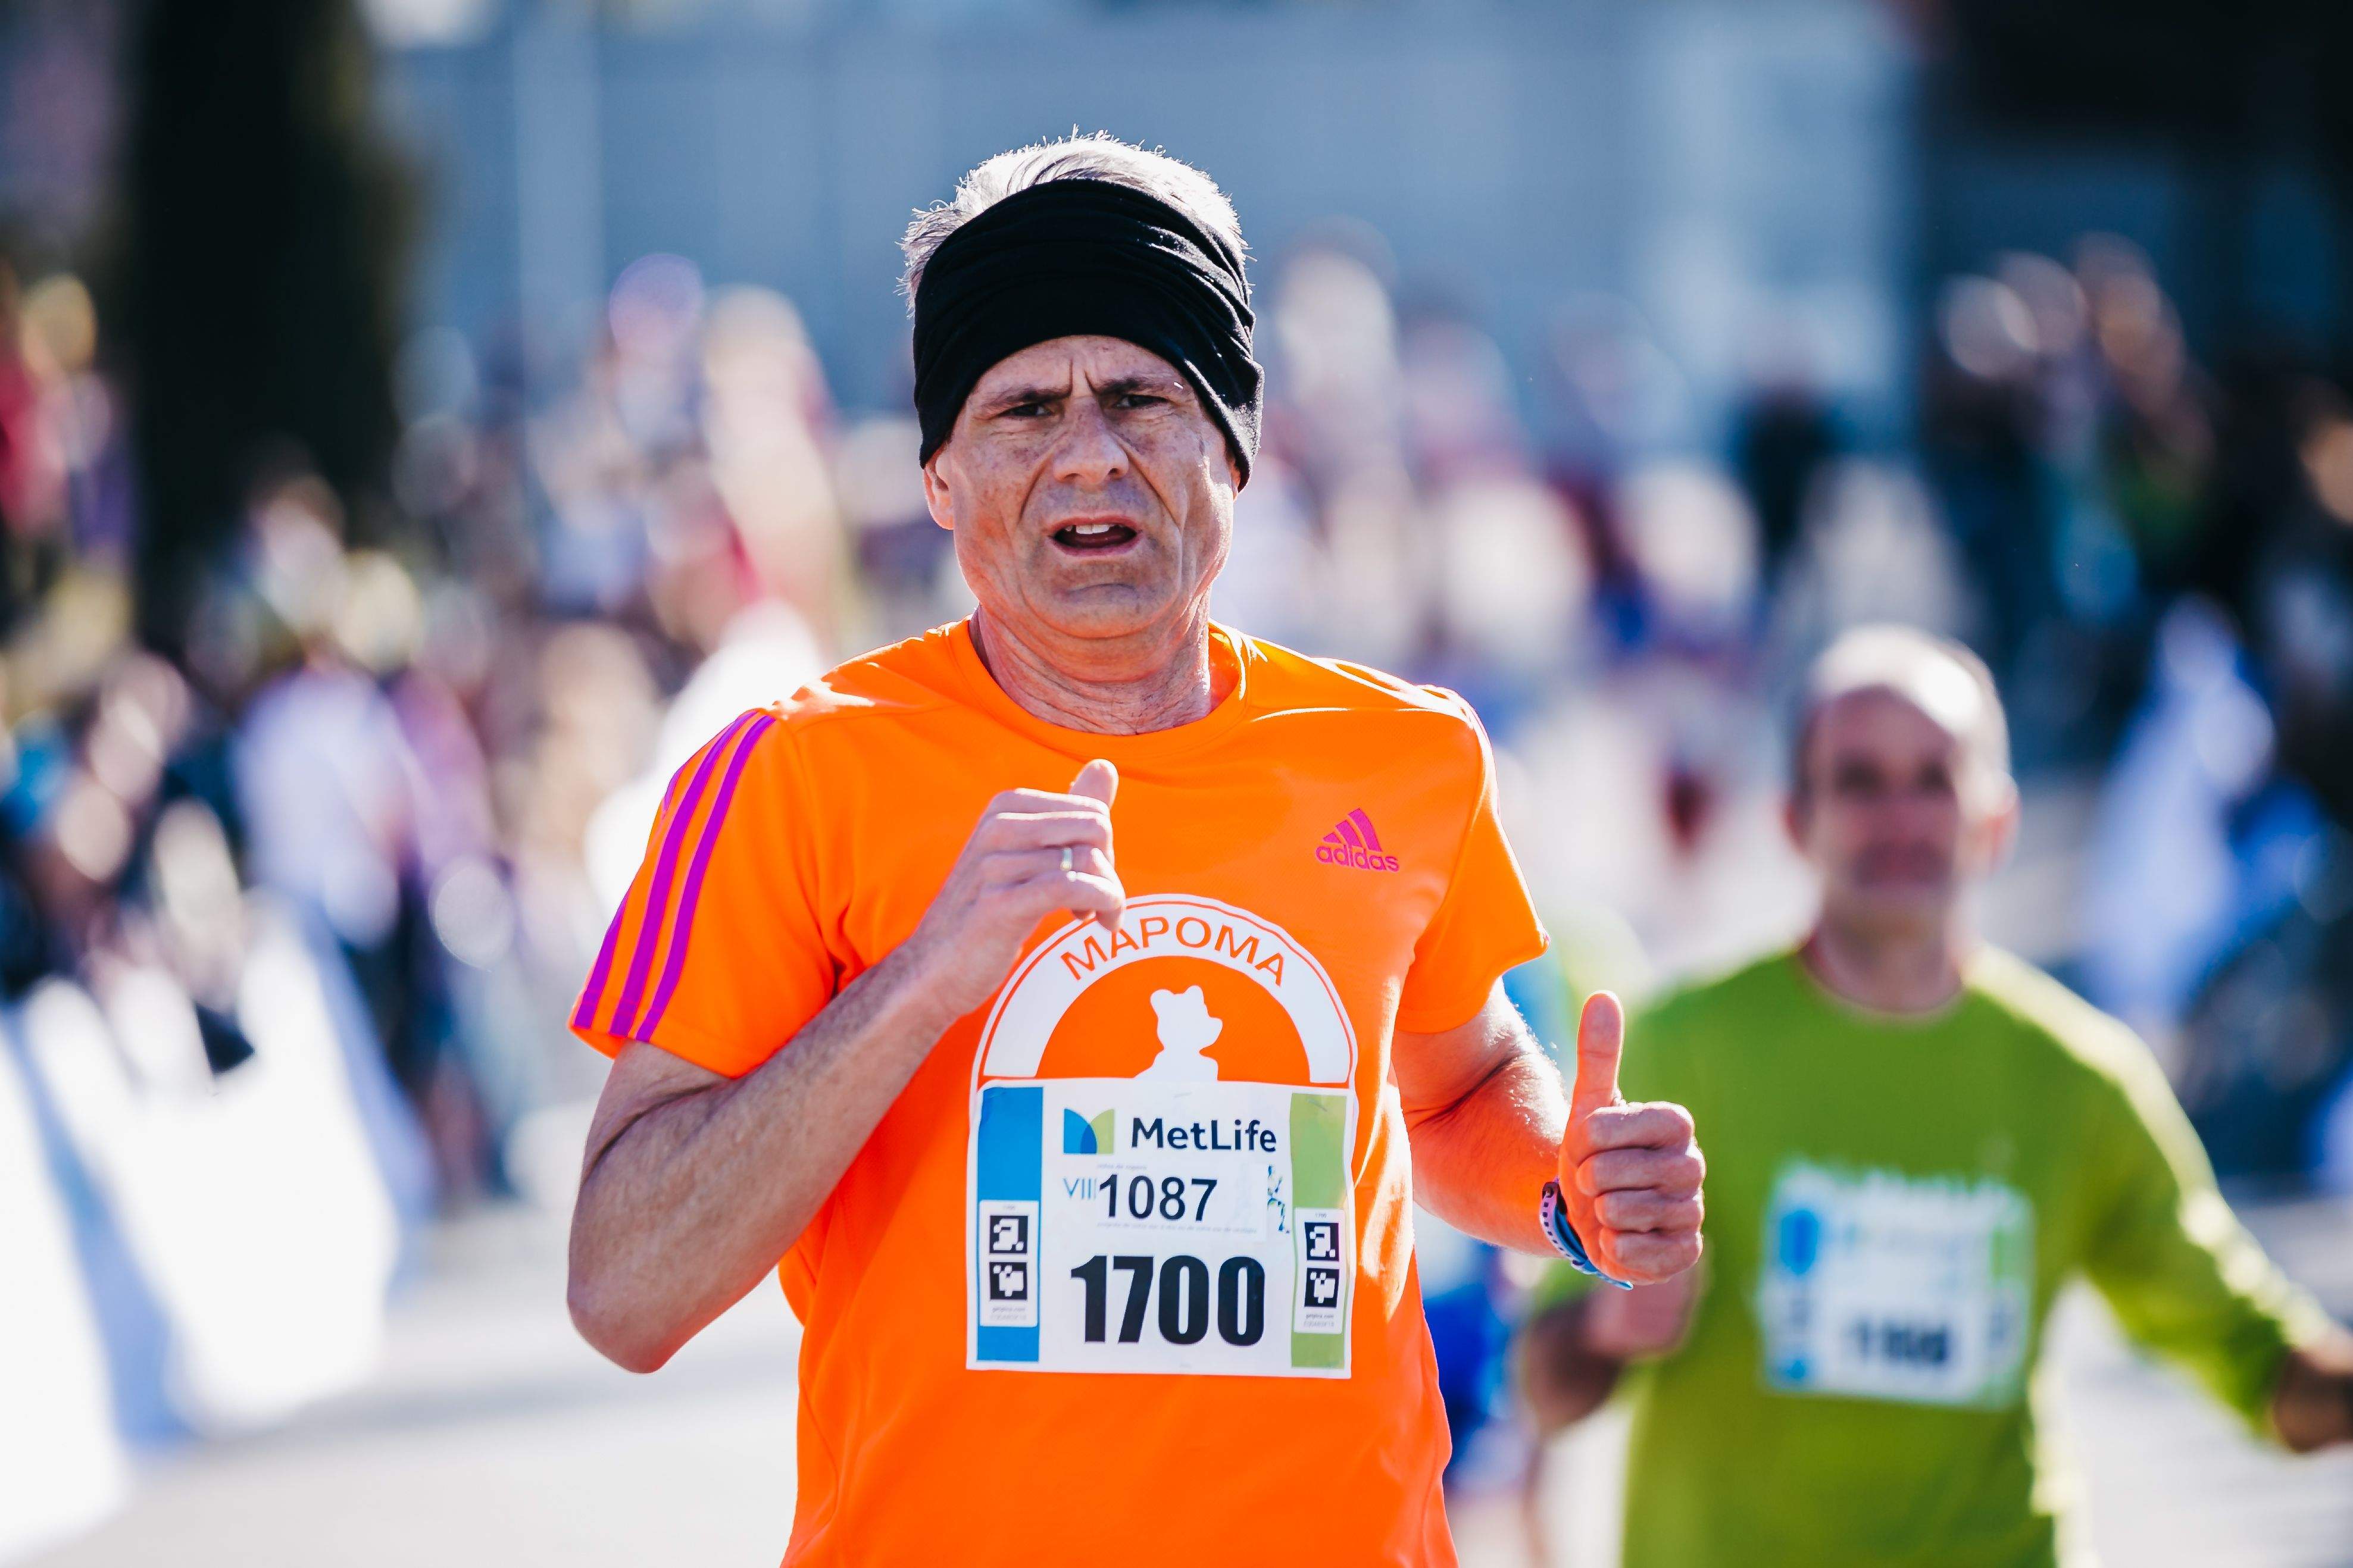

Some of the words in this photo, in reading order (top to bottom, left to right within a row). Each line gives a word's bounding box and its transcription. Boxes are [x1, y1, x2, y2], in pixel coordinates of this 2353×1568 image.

[1316, 844, 1399, 872] adidas
[1061, 916, 1286, 987] MAPOMA
[1132, 1117, 1277, 1152] MetLife
[1099, 1173, 1218, 1222] 1087
[1070, 1254, 1266, 1347] 1700
